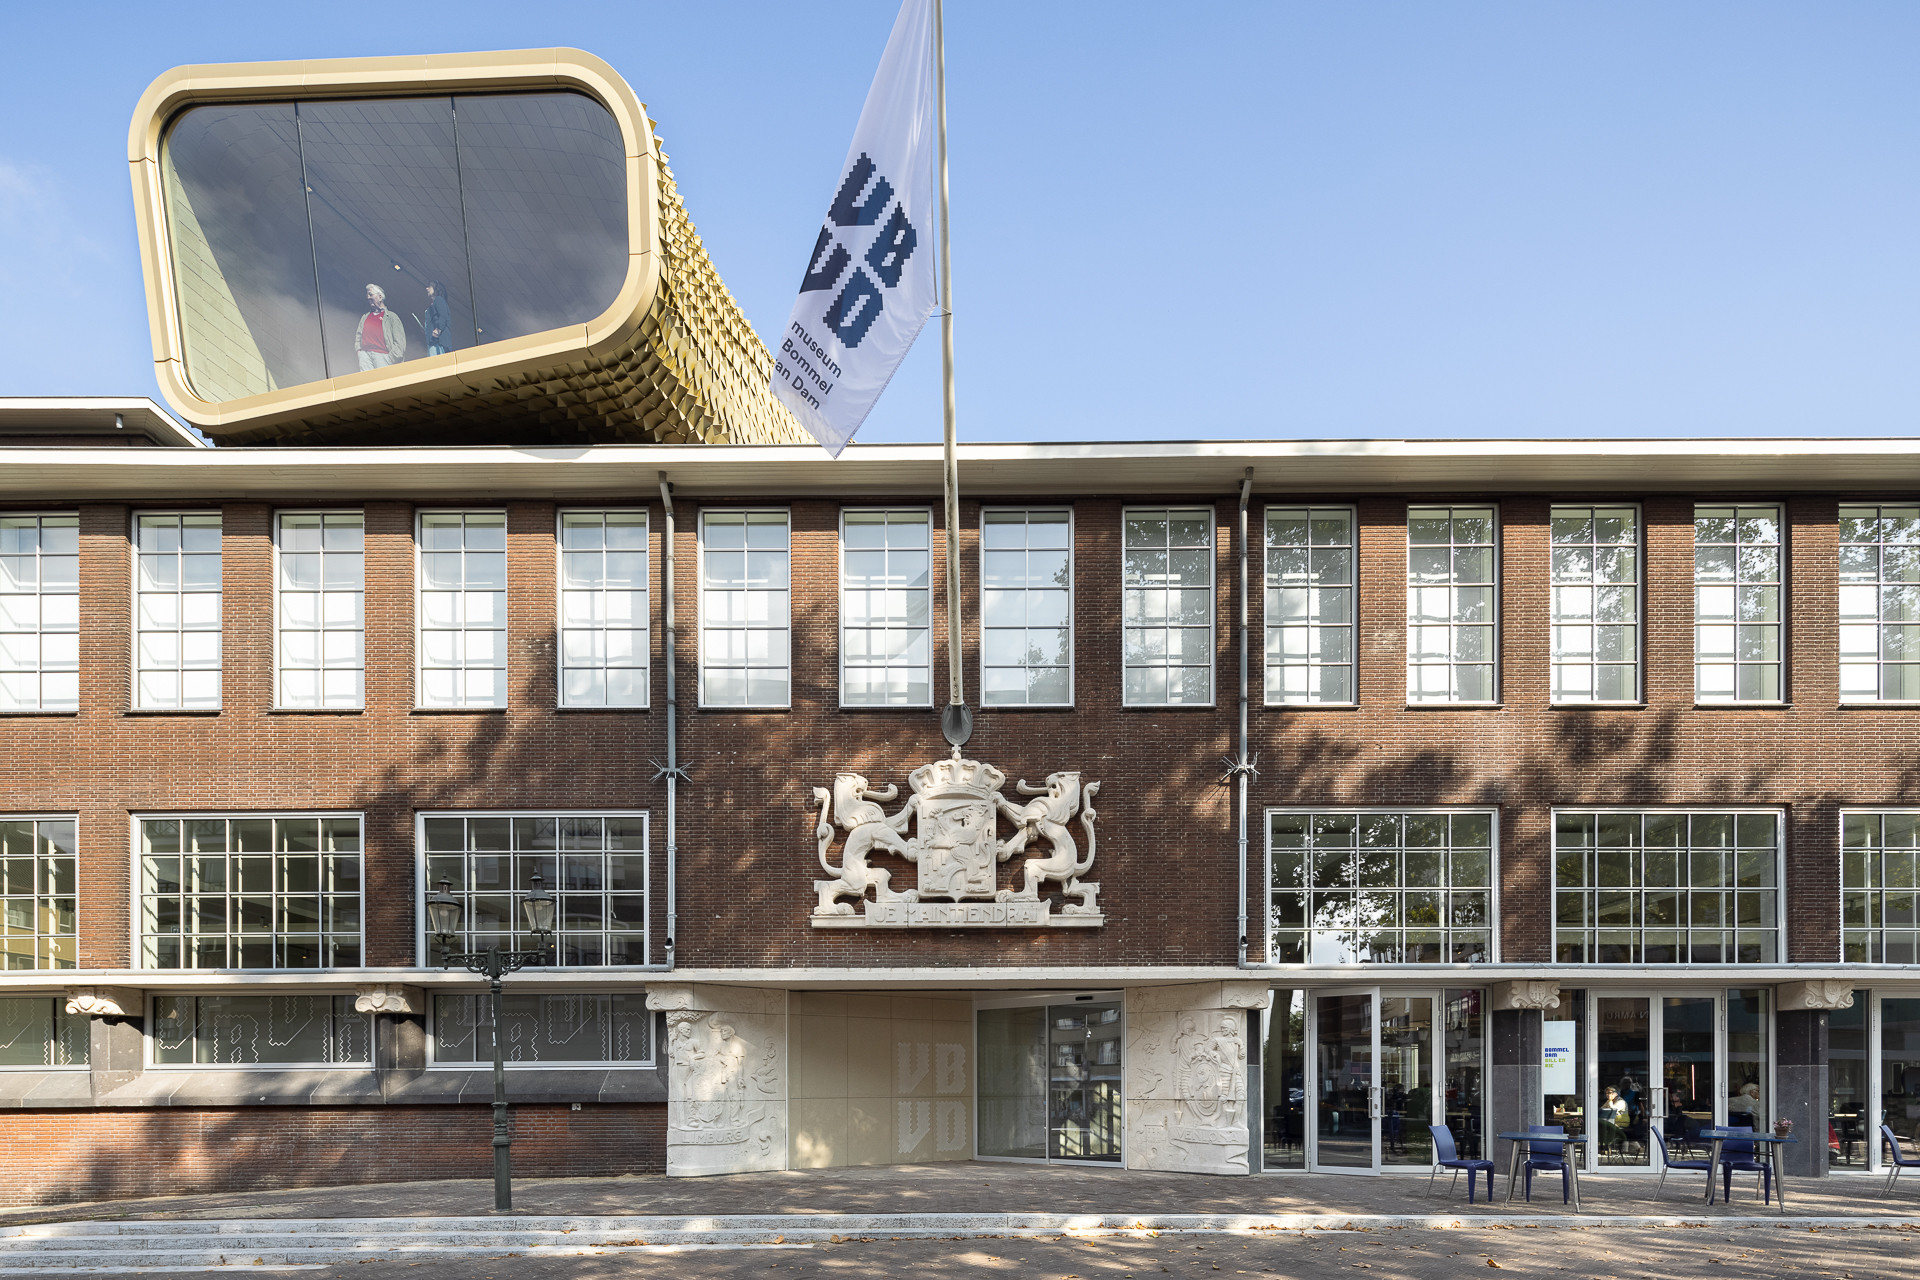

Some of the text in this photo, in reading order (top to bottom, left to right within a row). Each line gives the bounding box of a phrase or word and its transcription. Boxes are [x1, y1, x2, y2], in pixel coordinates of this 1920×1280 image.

[782, 338, 834, 396] Bommel
[791, 321, 842, 378] museum
[775, 359, 820, 410] an Dam
[875, 906, 1038, 923] JE MAINTIENDRAI
[681, 1131, 743, 1144] LIMBURG
